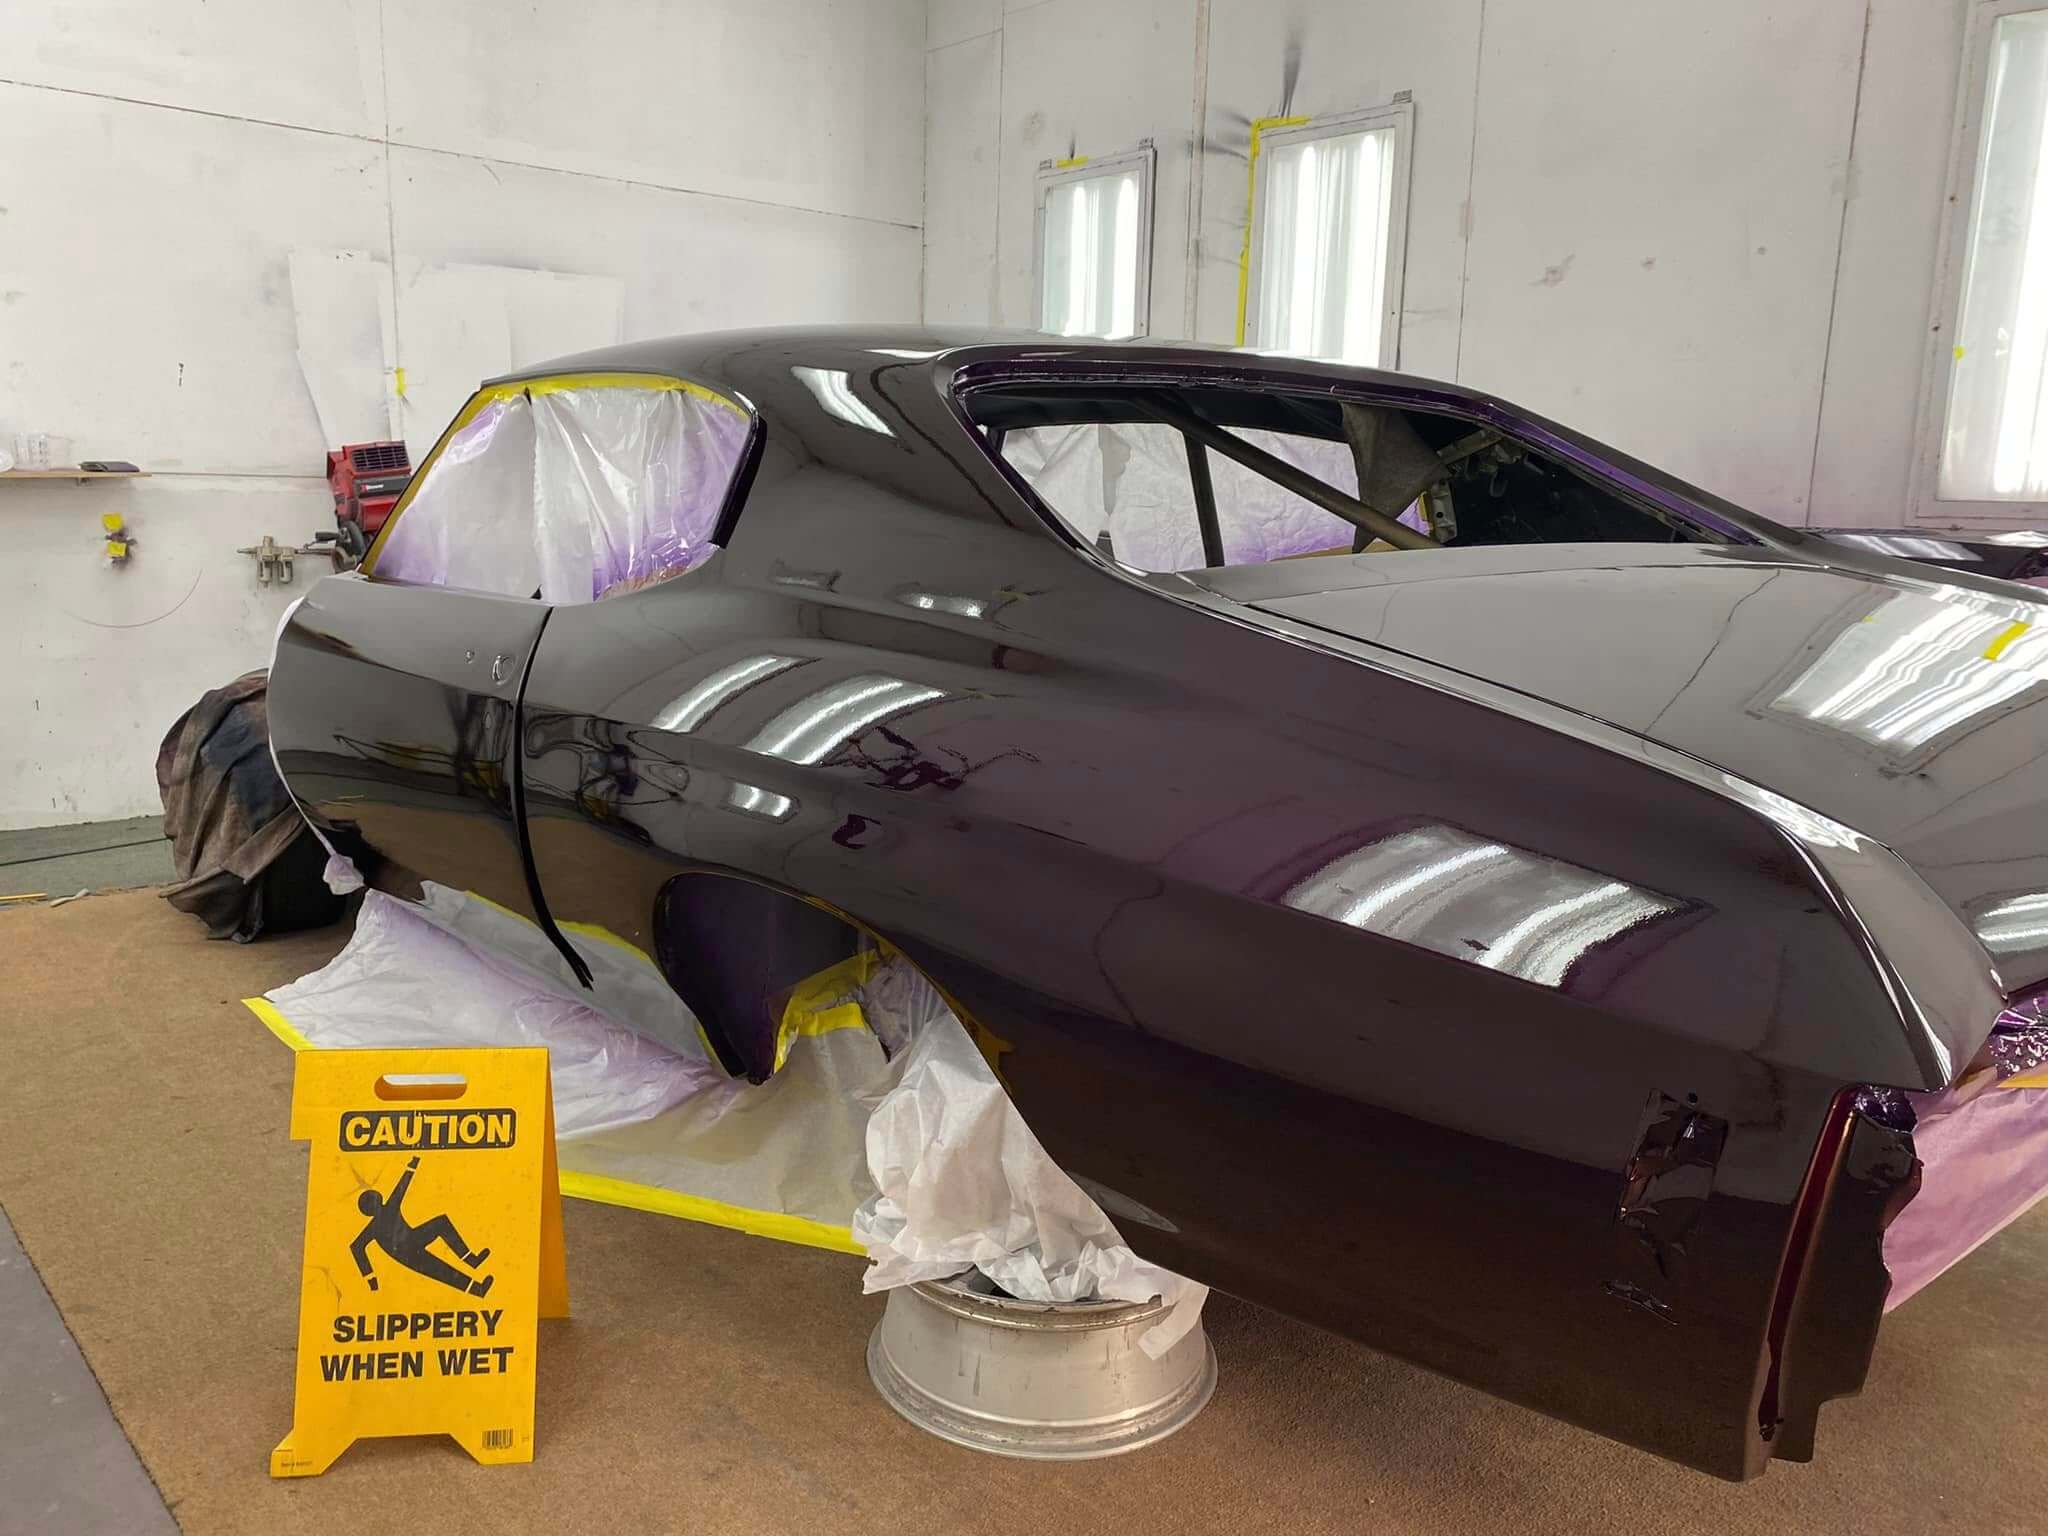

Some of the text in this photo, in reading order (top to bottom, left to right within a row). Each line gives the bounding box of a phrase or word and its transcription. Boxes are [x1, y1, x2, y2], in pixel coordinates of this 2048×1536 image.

[345, 1114, 511, 1146] CAUTION
[333, 1310, 503, 1342] SLIPPERY
[320, 1346, 514, 1382] WHEN WET
